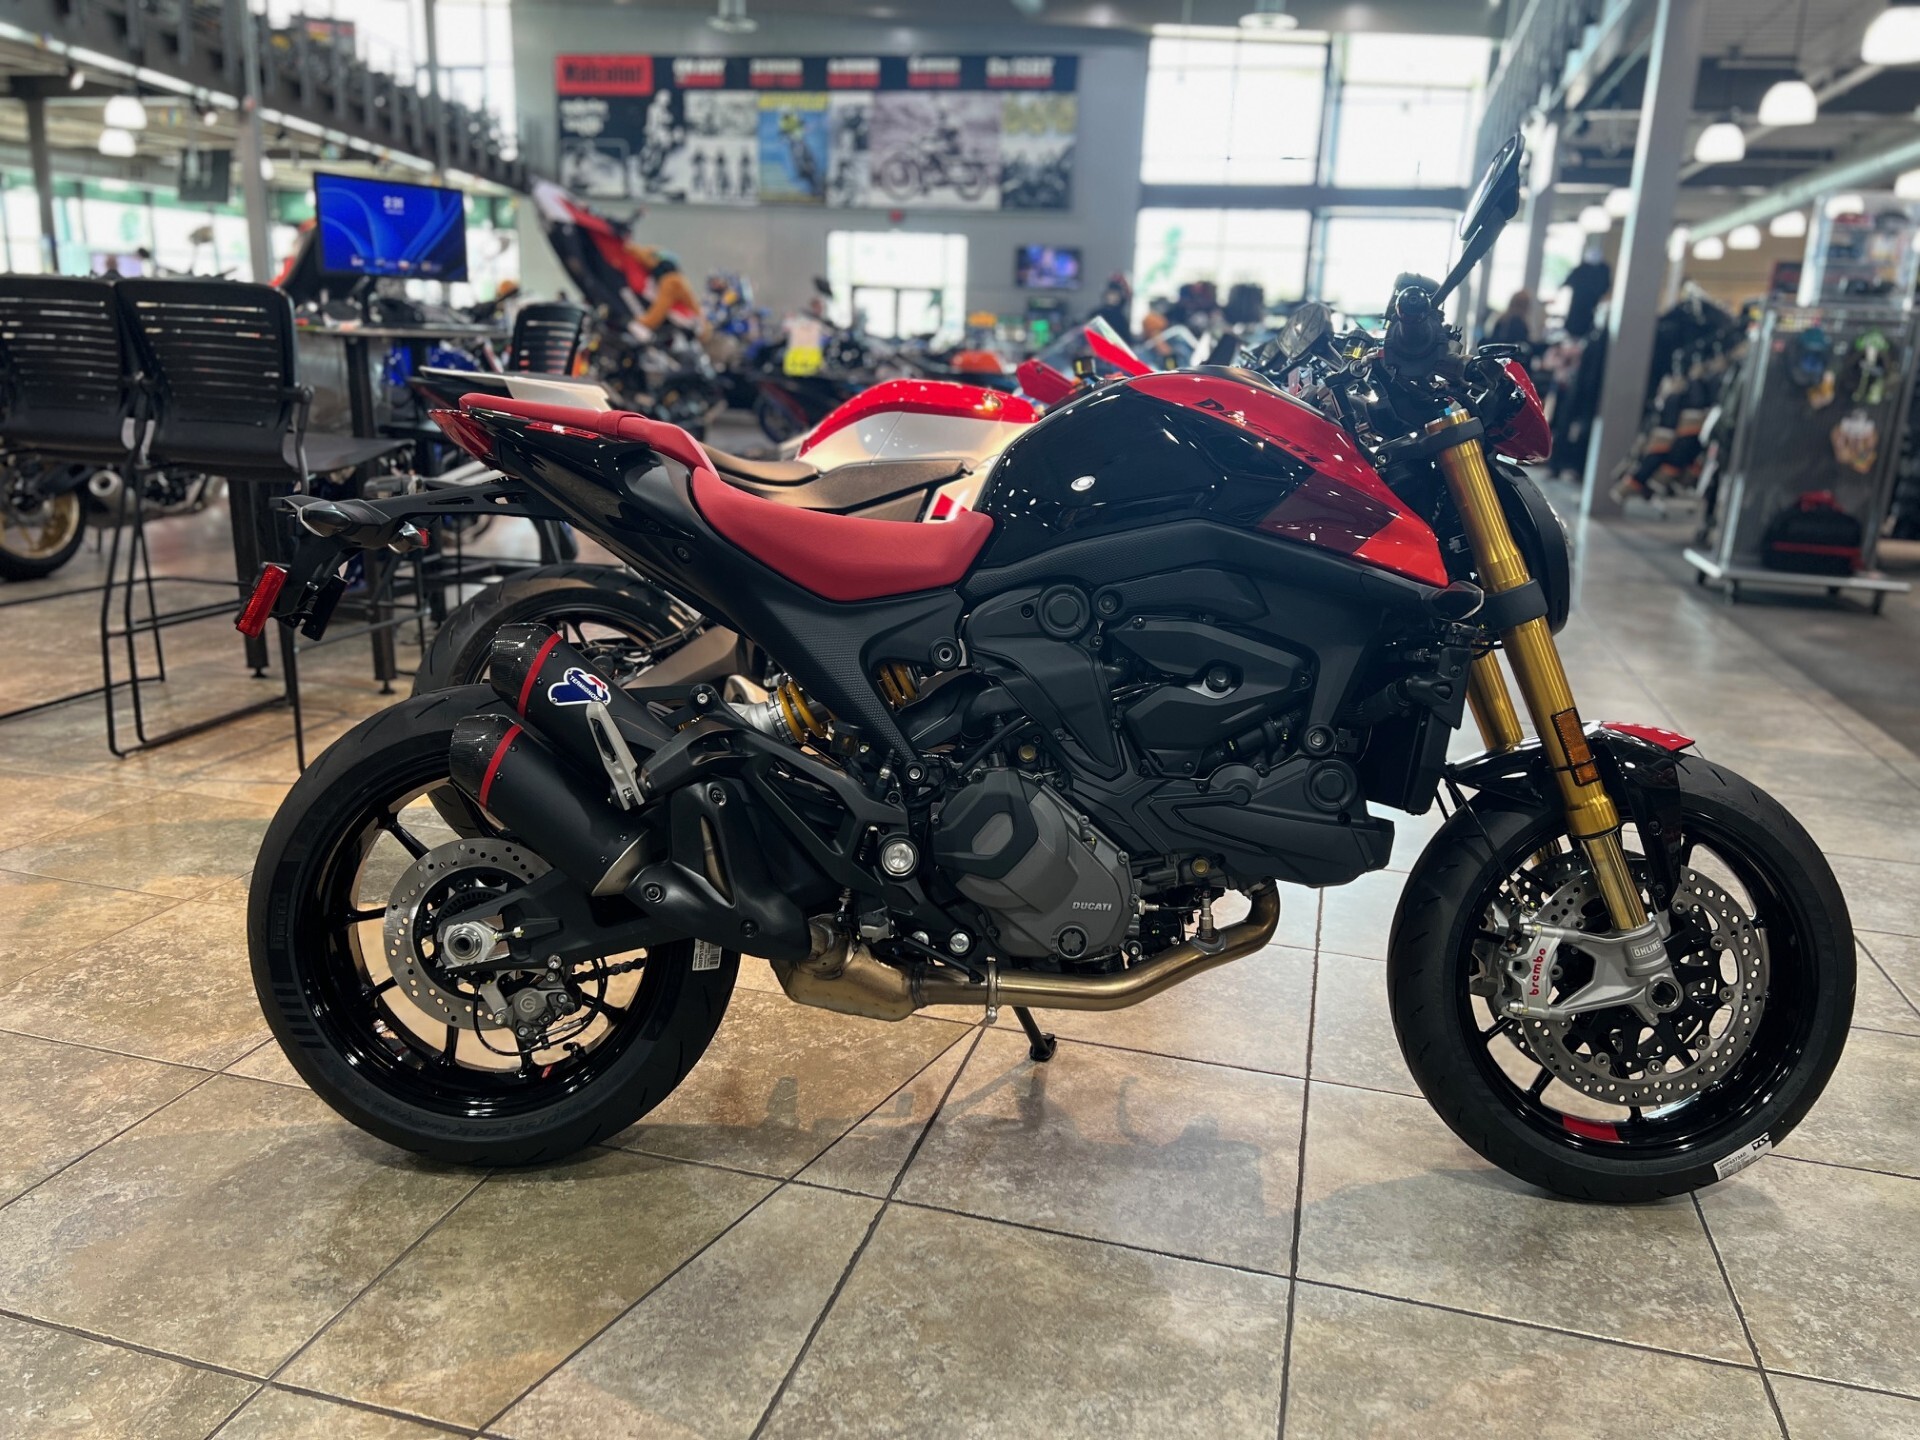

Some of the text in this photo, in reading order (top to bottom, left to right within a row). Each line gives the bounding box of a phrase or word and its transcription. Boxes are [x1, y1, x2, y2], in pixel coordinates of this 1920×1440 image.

[570, 676, 602, 701] TERMIGNON
[1072, 902, 1112, 911] DUCATI
[1529, 948, 1547, 996] brembo
